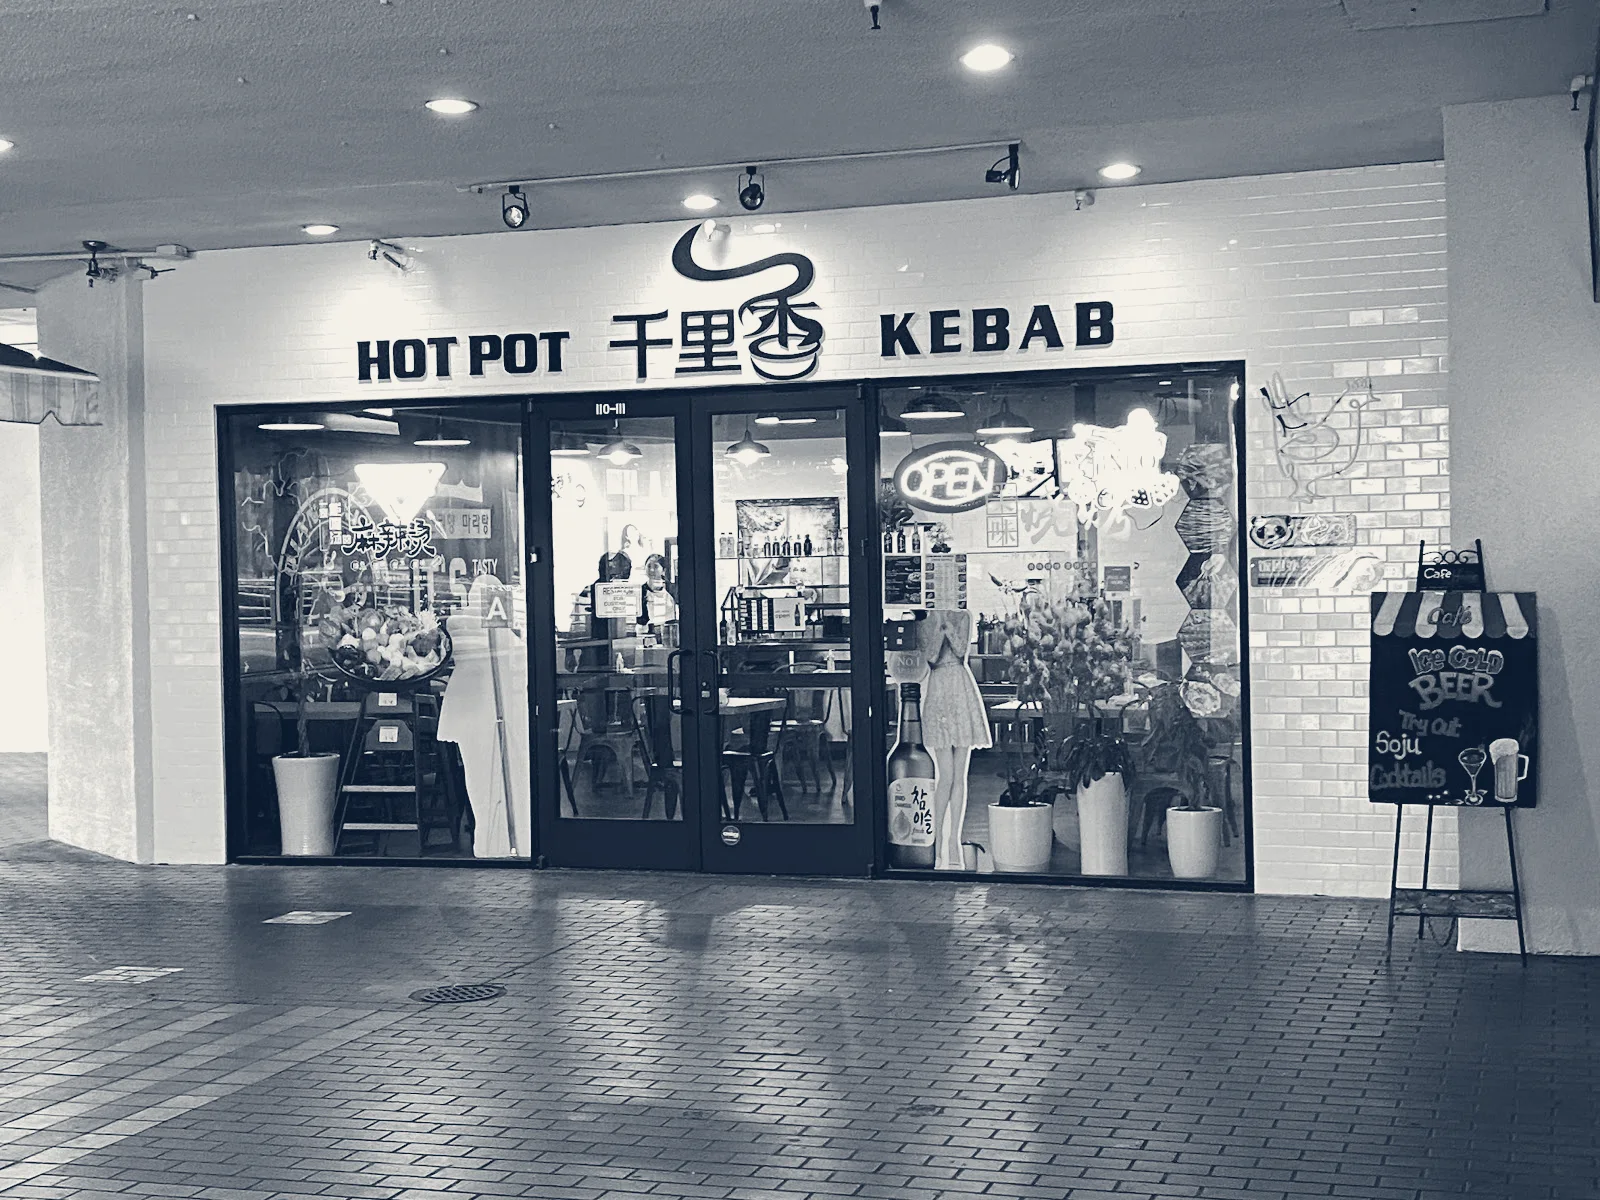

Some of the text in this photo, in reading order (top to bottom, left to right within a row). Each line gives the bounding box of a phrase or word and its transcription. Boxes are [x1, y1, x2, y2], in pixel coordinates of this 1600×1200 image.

[609, 292, 824, 380] 千里香
[880, 300, 1115, 357] KEBAB
[357, 330, 570, 382] HOT POT
[901, 458, 996, 498] OPEN
[472, 558, 498, 575] TASTY
[1423, 567, 1452, 580] Cafe
[485, 596, 508, 620] A
[1427, 606, 1473, 627] Café
[1408, 671, 1503, 711] BEER
[1398, 709, 1463, 738] Try Out
[1375, 730, 1423, 760] Soju
[1370, 760, 1447, 790] Cocktails
[911, 785, 933, 834] 참이슬
